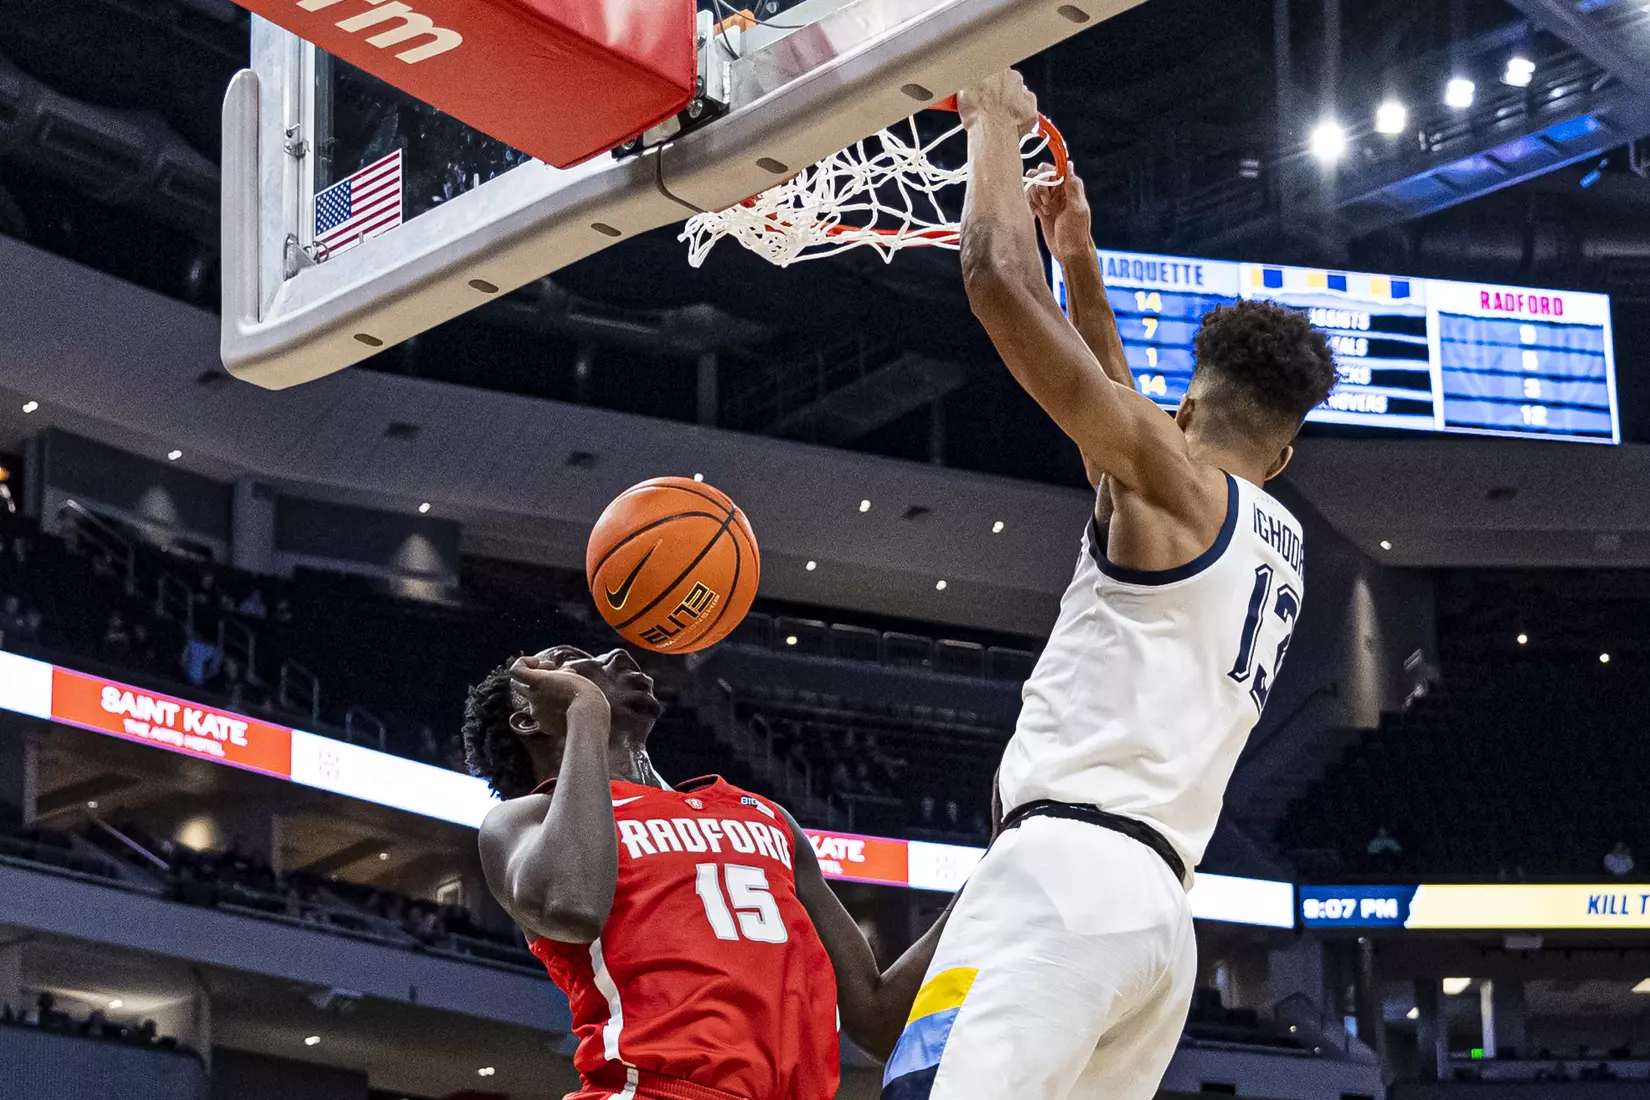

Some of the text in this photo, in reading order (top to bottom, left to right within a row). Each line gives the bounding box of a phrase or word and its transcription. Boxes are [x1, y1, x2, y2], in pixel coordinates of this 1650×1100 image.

[1134, 291, 1163, 313] 14
[1480, 291, 1563, 316] RADFORD
[1142, 318, 1158, 339] 7
[1146, 347, 1158, 368] 1
[1138, 374, 1167, 396] 14
[638, 580, 717, 645] ELITE
[100, 685, 248, 747] SAINT KATE
[617, 818, 793, 870] RADFORD
[695, 863, 789, 944] 15
[1360, 898, 1398, 919] PM
[1587, 894, 1630, 915] KILL
